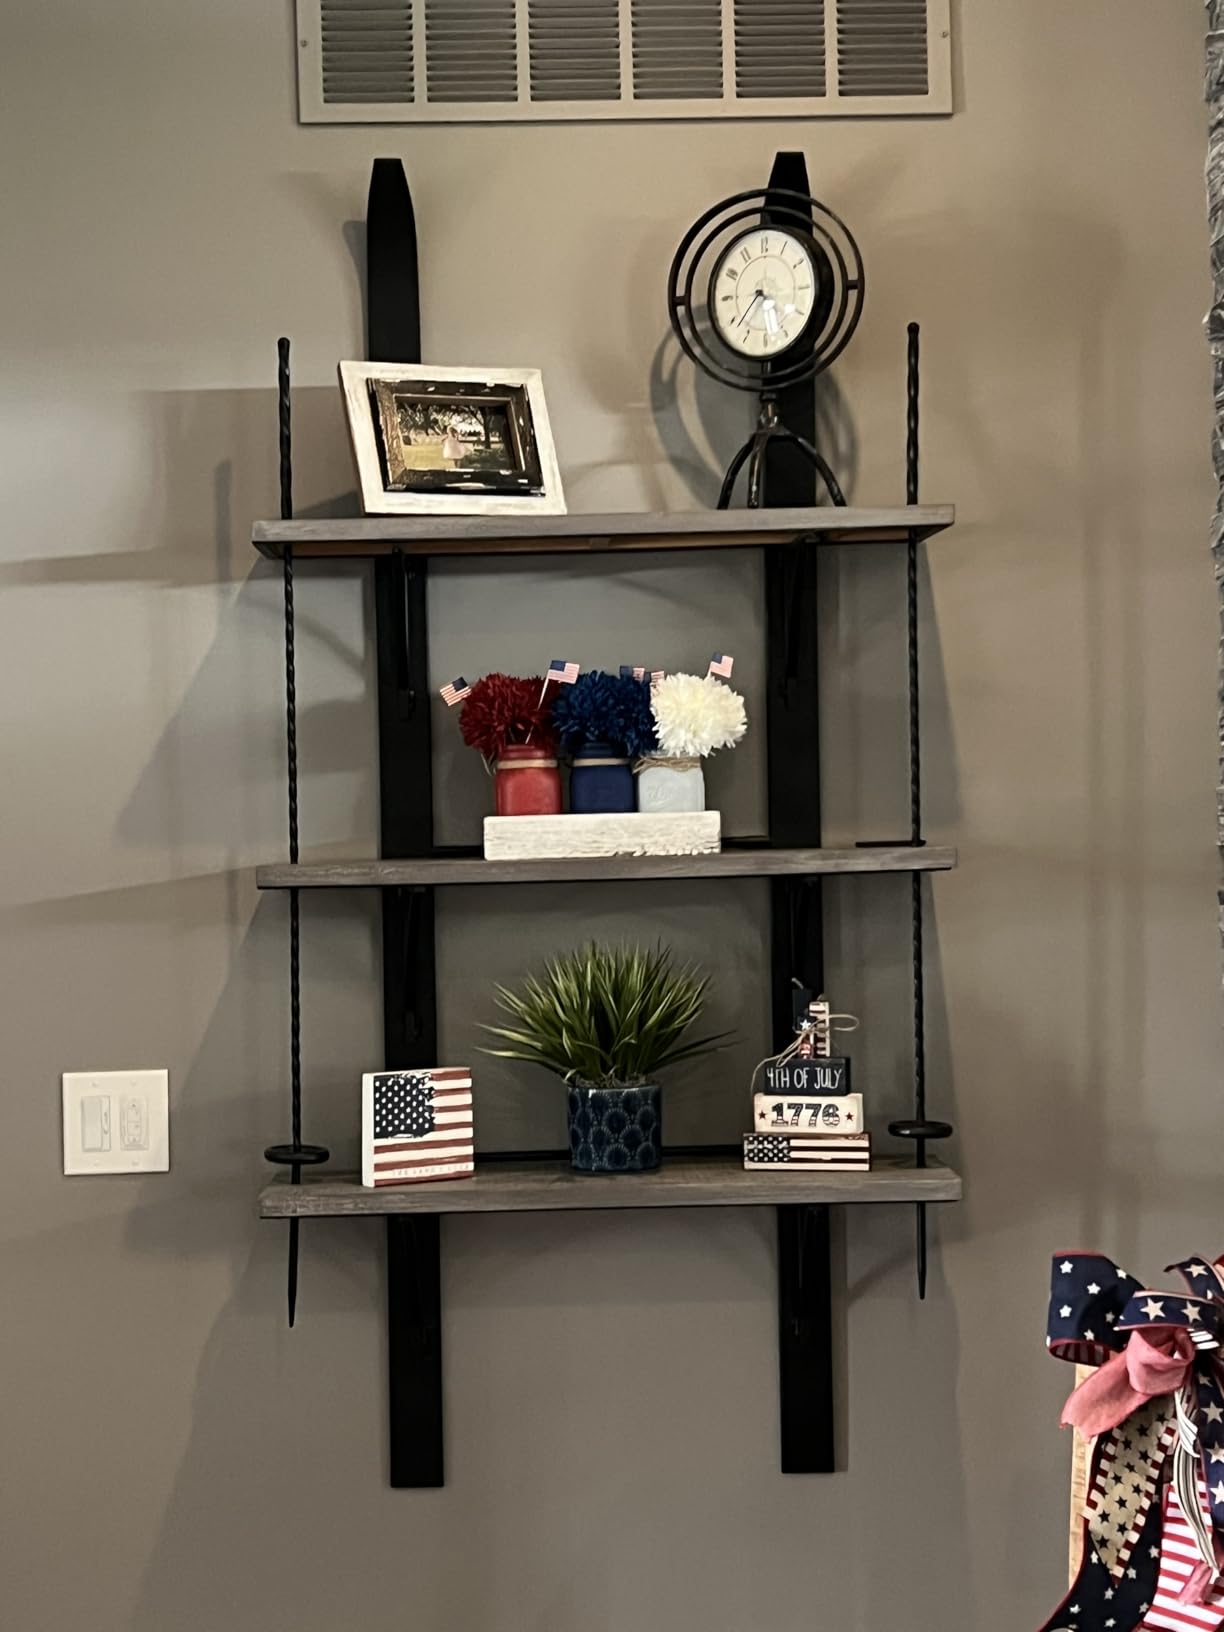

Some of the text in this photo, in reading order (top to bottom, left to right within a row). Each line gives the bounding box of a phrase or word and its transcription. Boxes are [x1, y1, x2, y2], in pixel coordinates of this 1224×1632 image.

[766, 1066, 842, 1089] 4TH OF JULY
[771, 1102, 841, 1128] 1776
